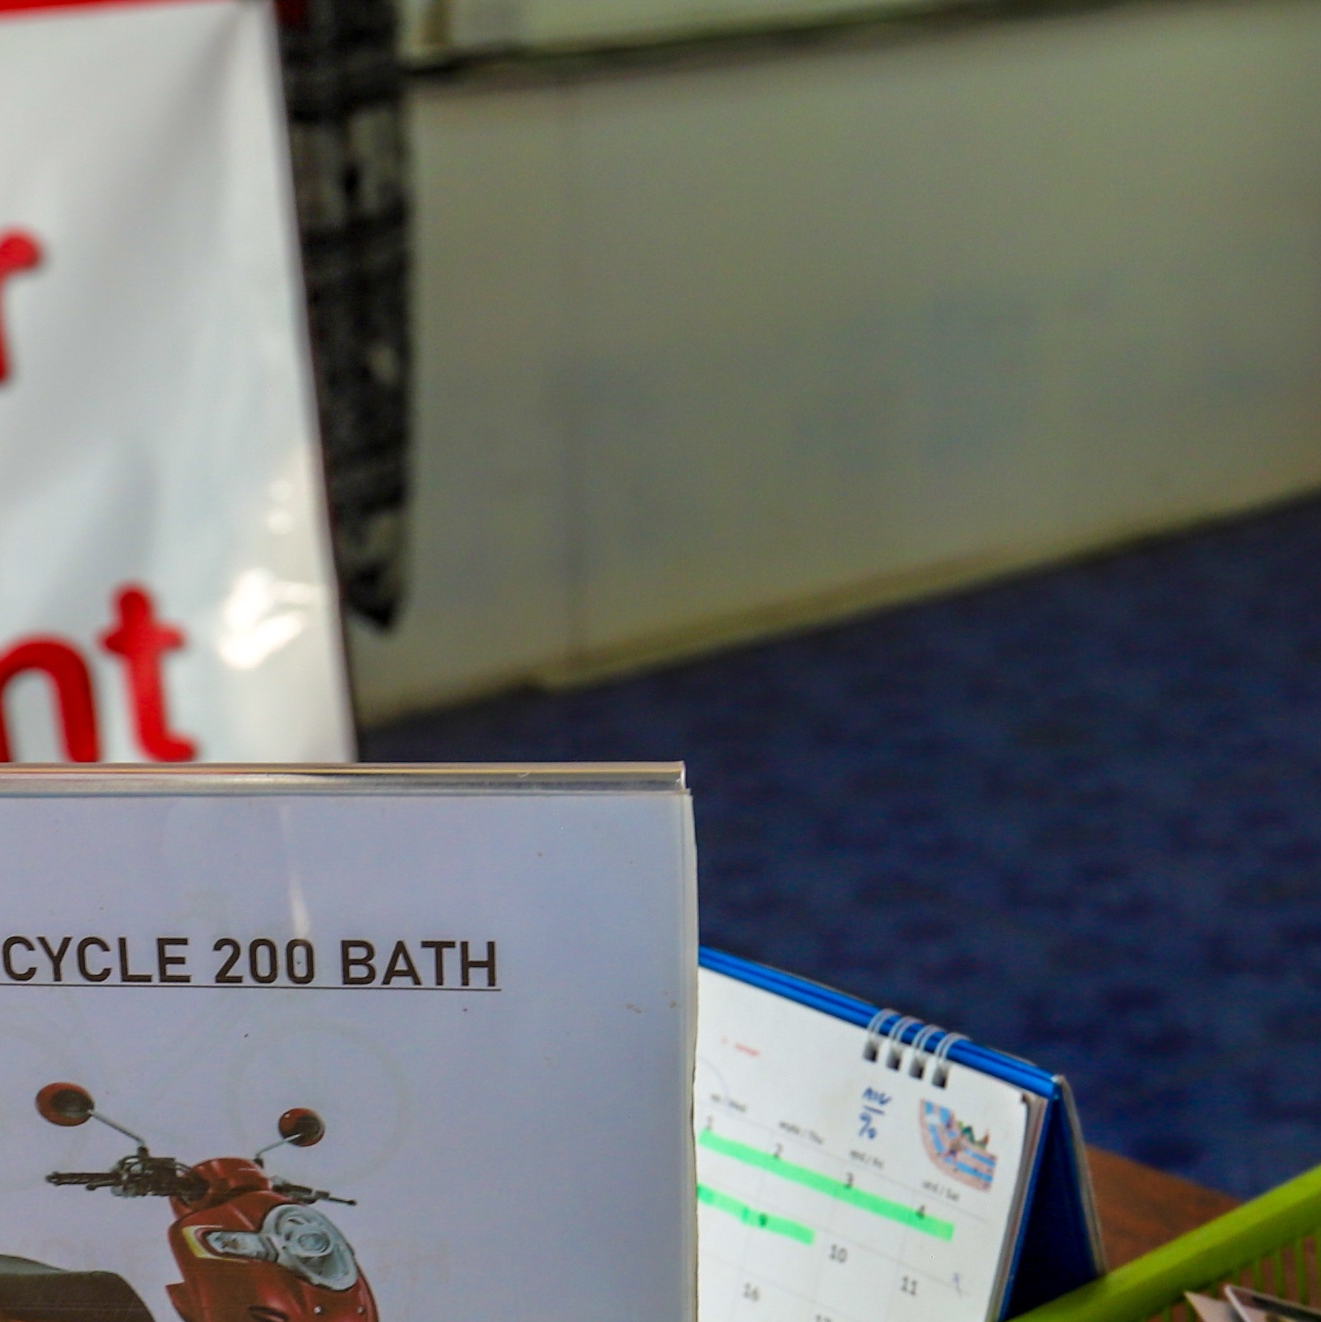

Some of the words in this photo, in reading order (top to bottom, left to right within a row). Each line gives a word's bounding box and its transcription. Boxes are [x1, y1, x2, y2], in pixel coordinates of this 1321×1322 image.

[212, 937, 315, 985] 200
[340, 940, 498, 988] BATH
[843, 1171, 854, 1190] 3
[915, 1204, 927, 1221] 4
[742, 1282, 761, 1302] 16
[828, 1243, 849, 1264] 10
[900, 1275, 919, 1296] 11
